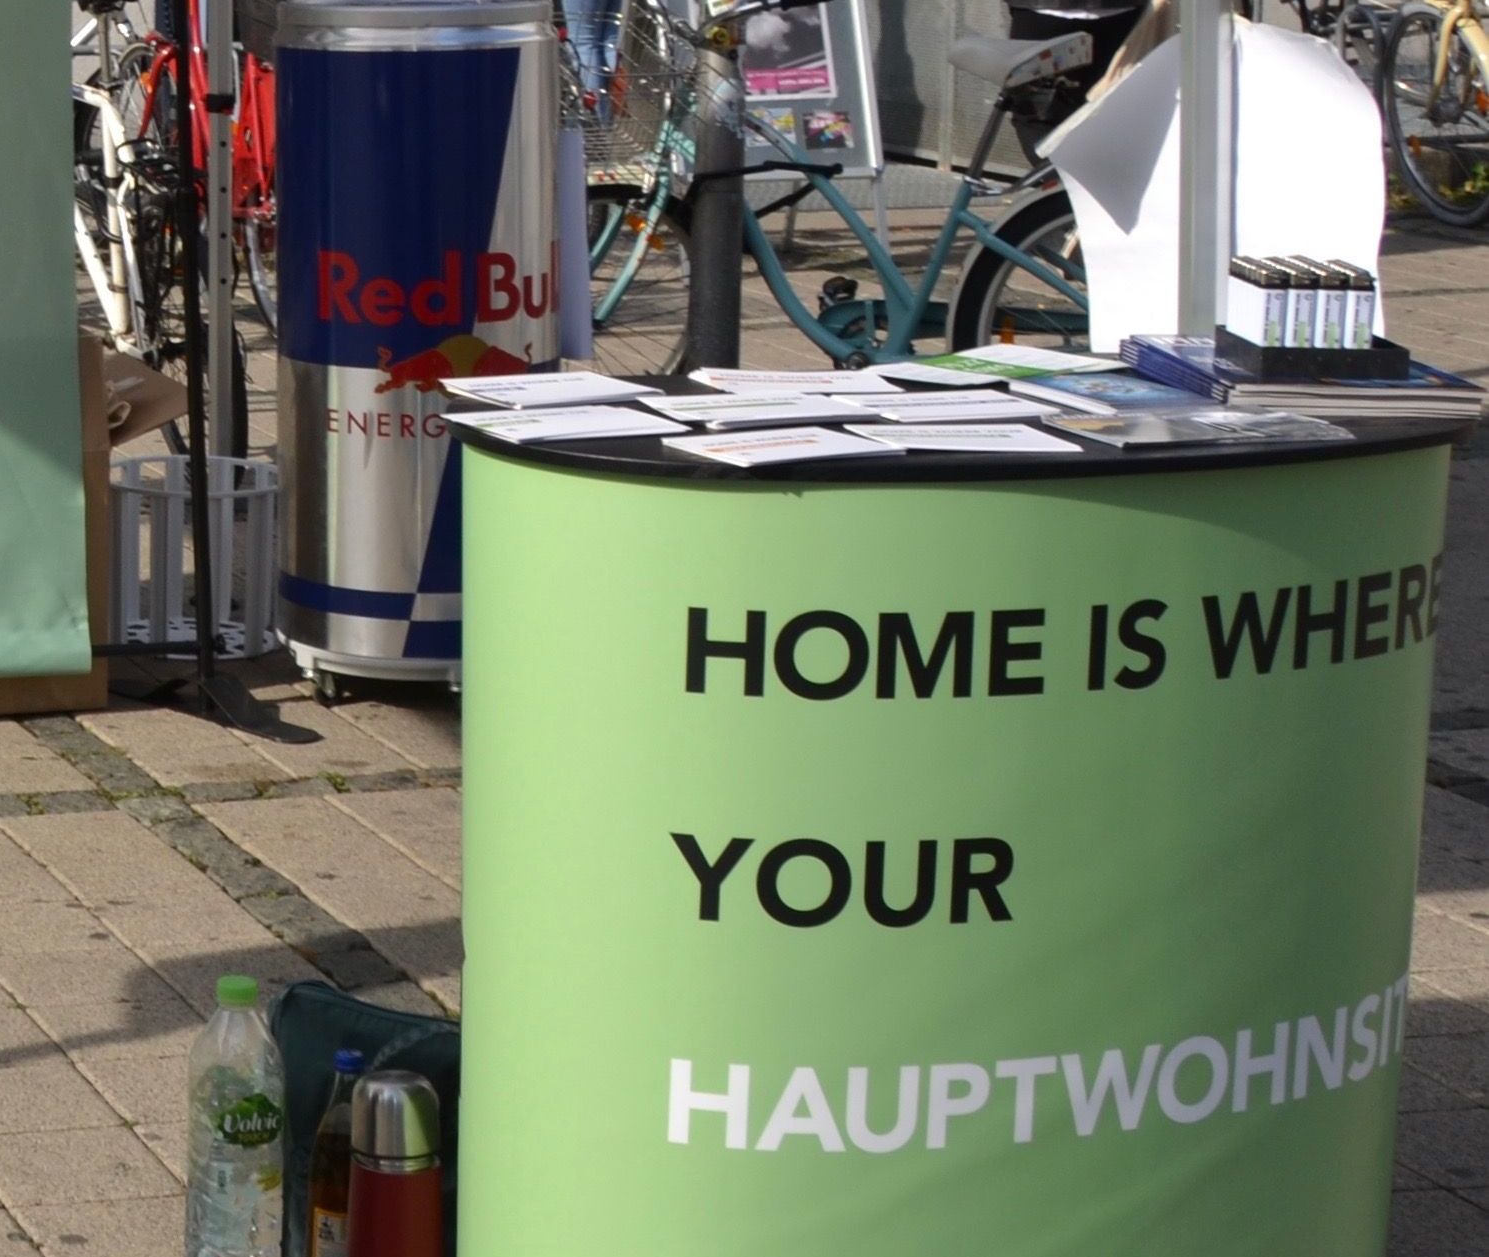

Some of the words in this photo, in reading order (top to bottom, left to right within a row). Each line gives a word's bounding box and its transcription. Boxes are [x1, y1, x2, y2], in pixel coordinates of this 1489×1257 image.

[316, 250, 463, 328] Red
[476, 241, 561, 324] Bul
[326, 408, 447, 439] ENERG
[686, 607, 1046, 701] HOME
[1087, 598, 1168, 691] IS
[670, 832, 1015, 928] YOUR
[667, 972, 1409, 1155] HAUPTWOHNSIT
[223, 1111, 280, 1134] Volvic
